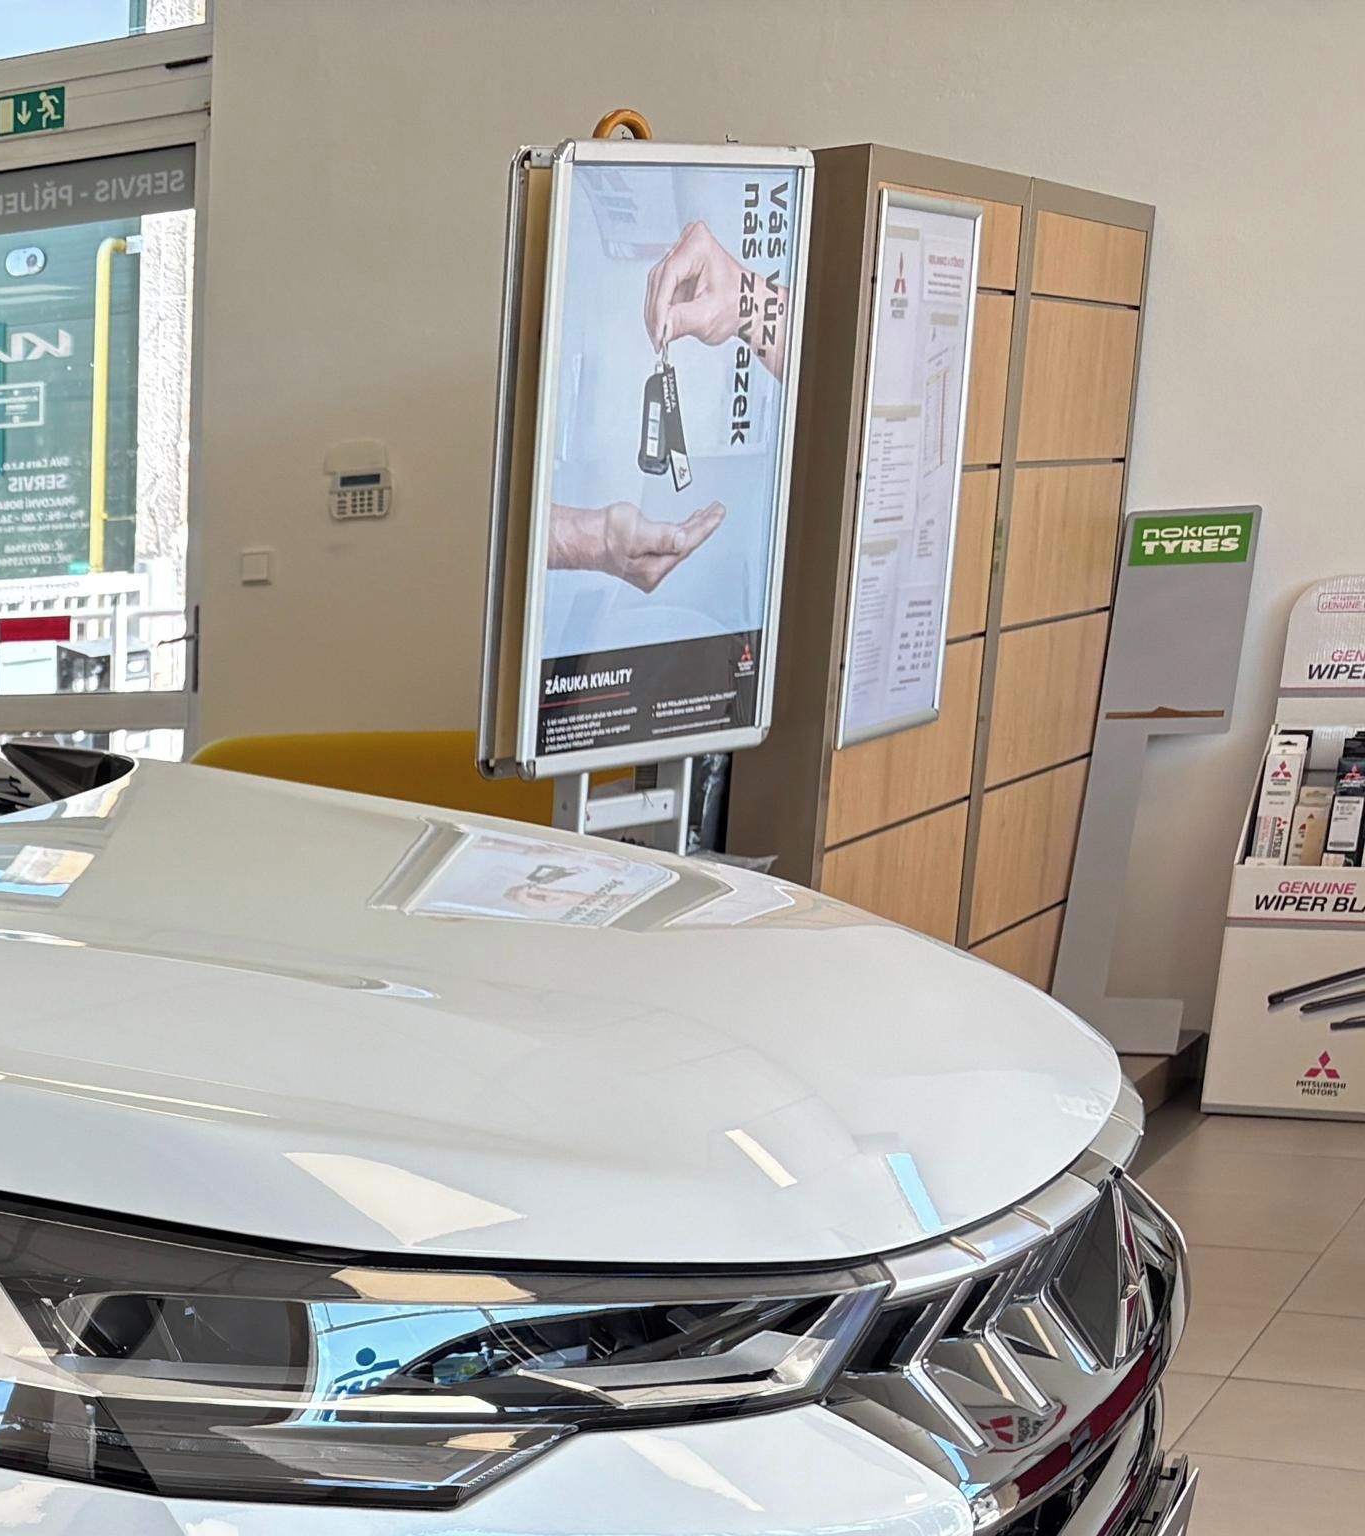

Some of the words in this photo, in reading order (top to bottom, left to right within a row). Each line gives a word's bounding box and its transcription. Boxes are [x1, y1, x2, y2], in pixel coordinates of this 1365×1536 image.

[742, 183, 763, 260] náš
[768, 181, 789, 259] Váš
[730, 271, 758, 446] závazek
[1142, 524, 1242, 540] nokian
[1141, 537, 1239, 555] TYRES
[1308, 664, 1365, 680] WIPE
[545, 673, 589, 695] ZÁRUKA
[590, 668, 633, 689] KVALITY
[1278, 881, 1357, 895] GENUINE
[1254, 894, 1328, 912] WIPER
[1296, 1080, 1346, 1089] MITSUBISHI
[1302, 1088, 1338, 1097] MOTORS
